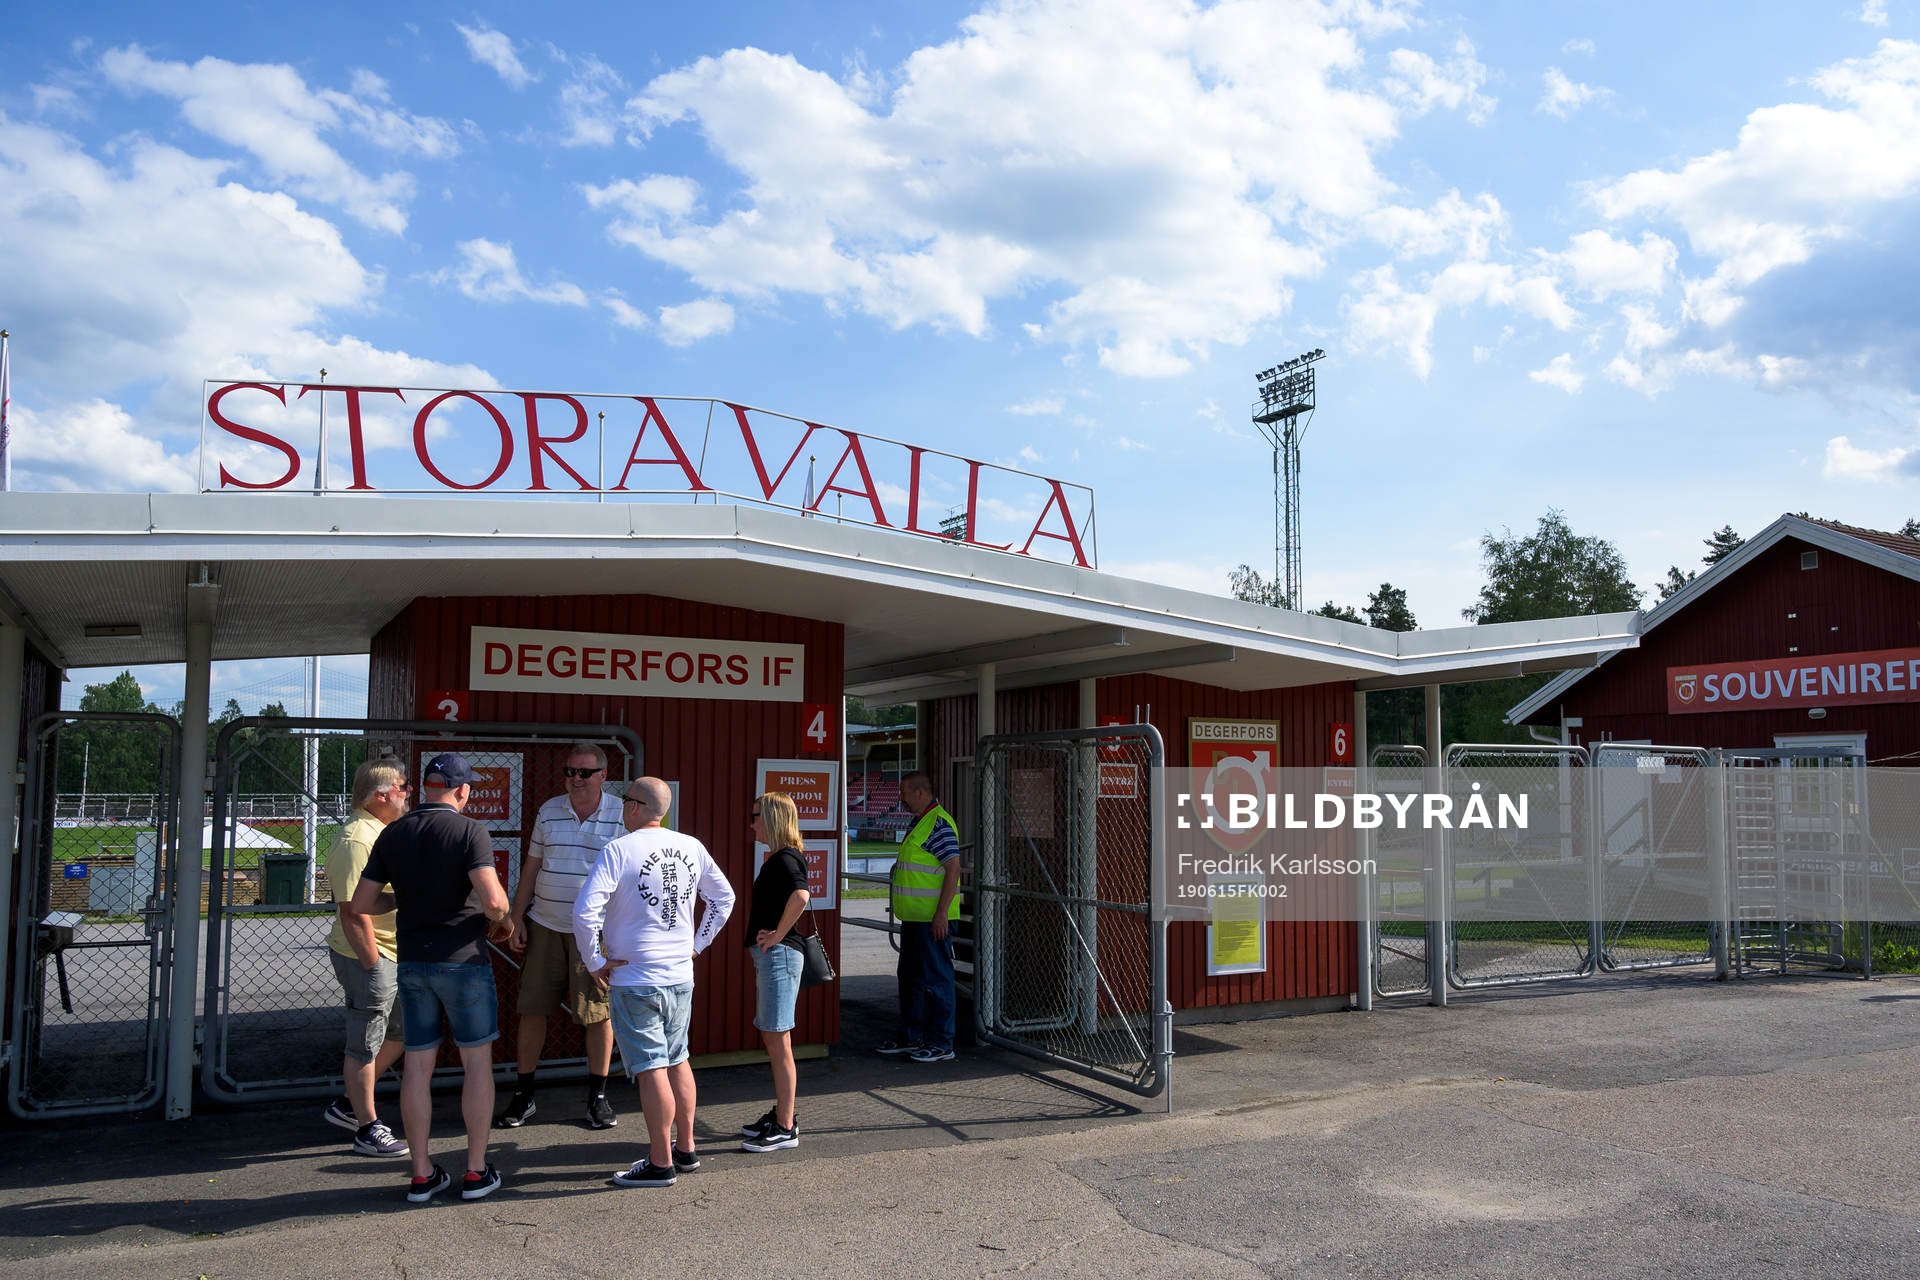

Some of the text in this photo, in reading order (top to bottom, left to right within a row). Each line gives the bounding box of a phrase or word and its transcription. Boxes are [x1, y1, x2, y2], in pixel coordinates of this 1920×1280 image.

[206, 382, 1095, 570] STORA VALLA
[484, 642, 795, 687] DEGERFORS IF
[807, 710, 828, 744] 4
[1195, 724, 1274, 739] DEGERFORS
[1334, 728, 1346, 756] 6
[779, 776, 817, 785] PRESS
[638, 848, 695, 907] OFF THE WALL
[660, 863, 671, 893] SINCE
[668, 862, 678, 931] THE ORIGINAL
